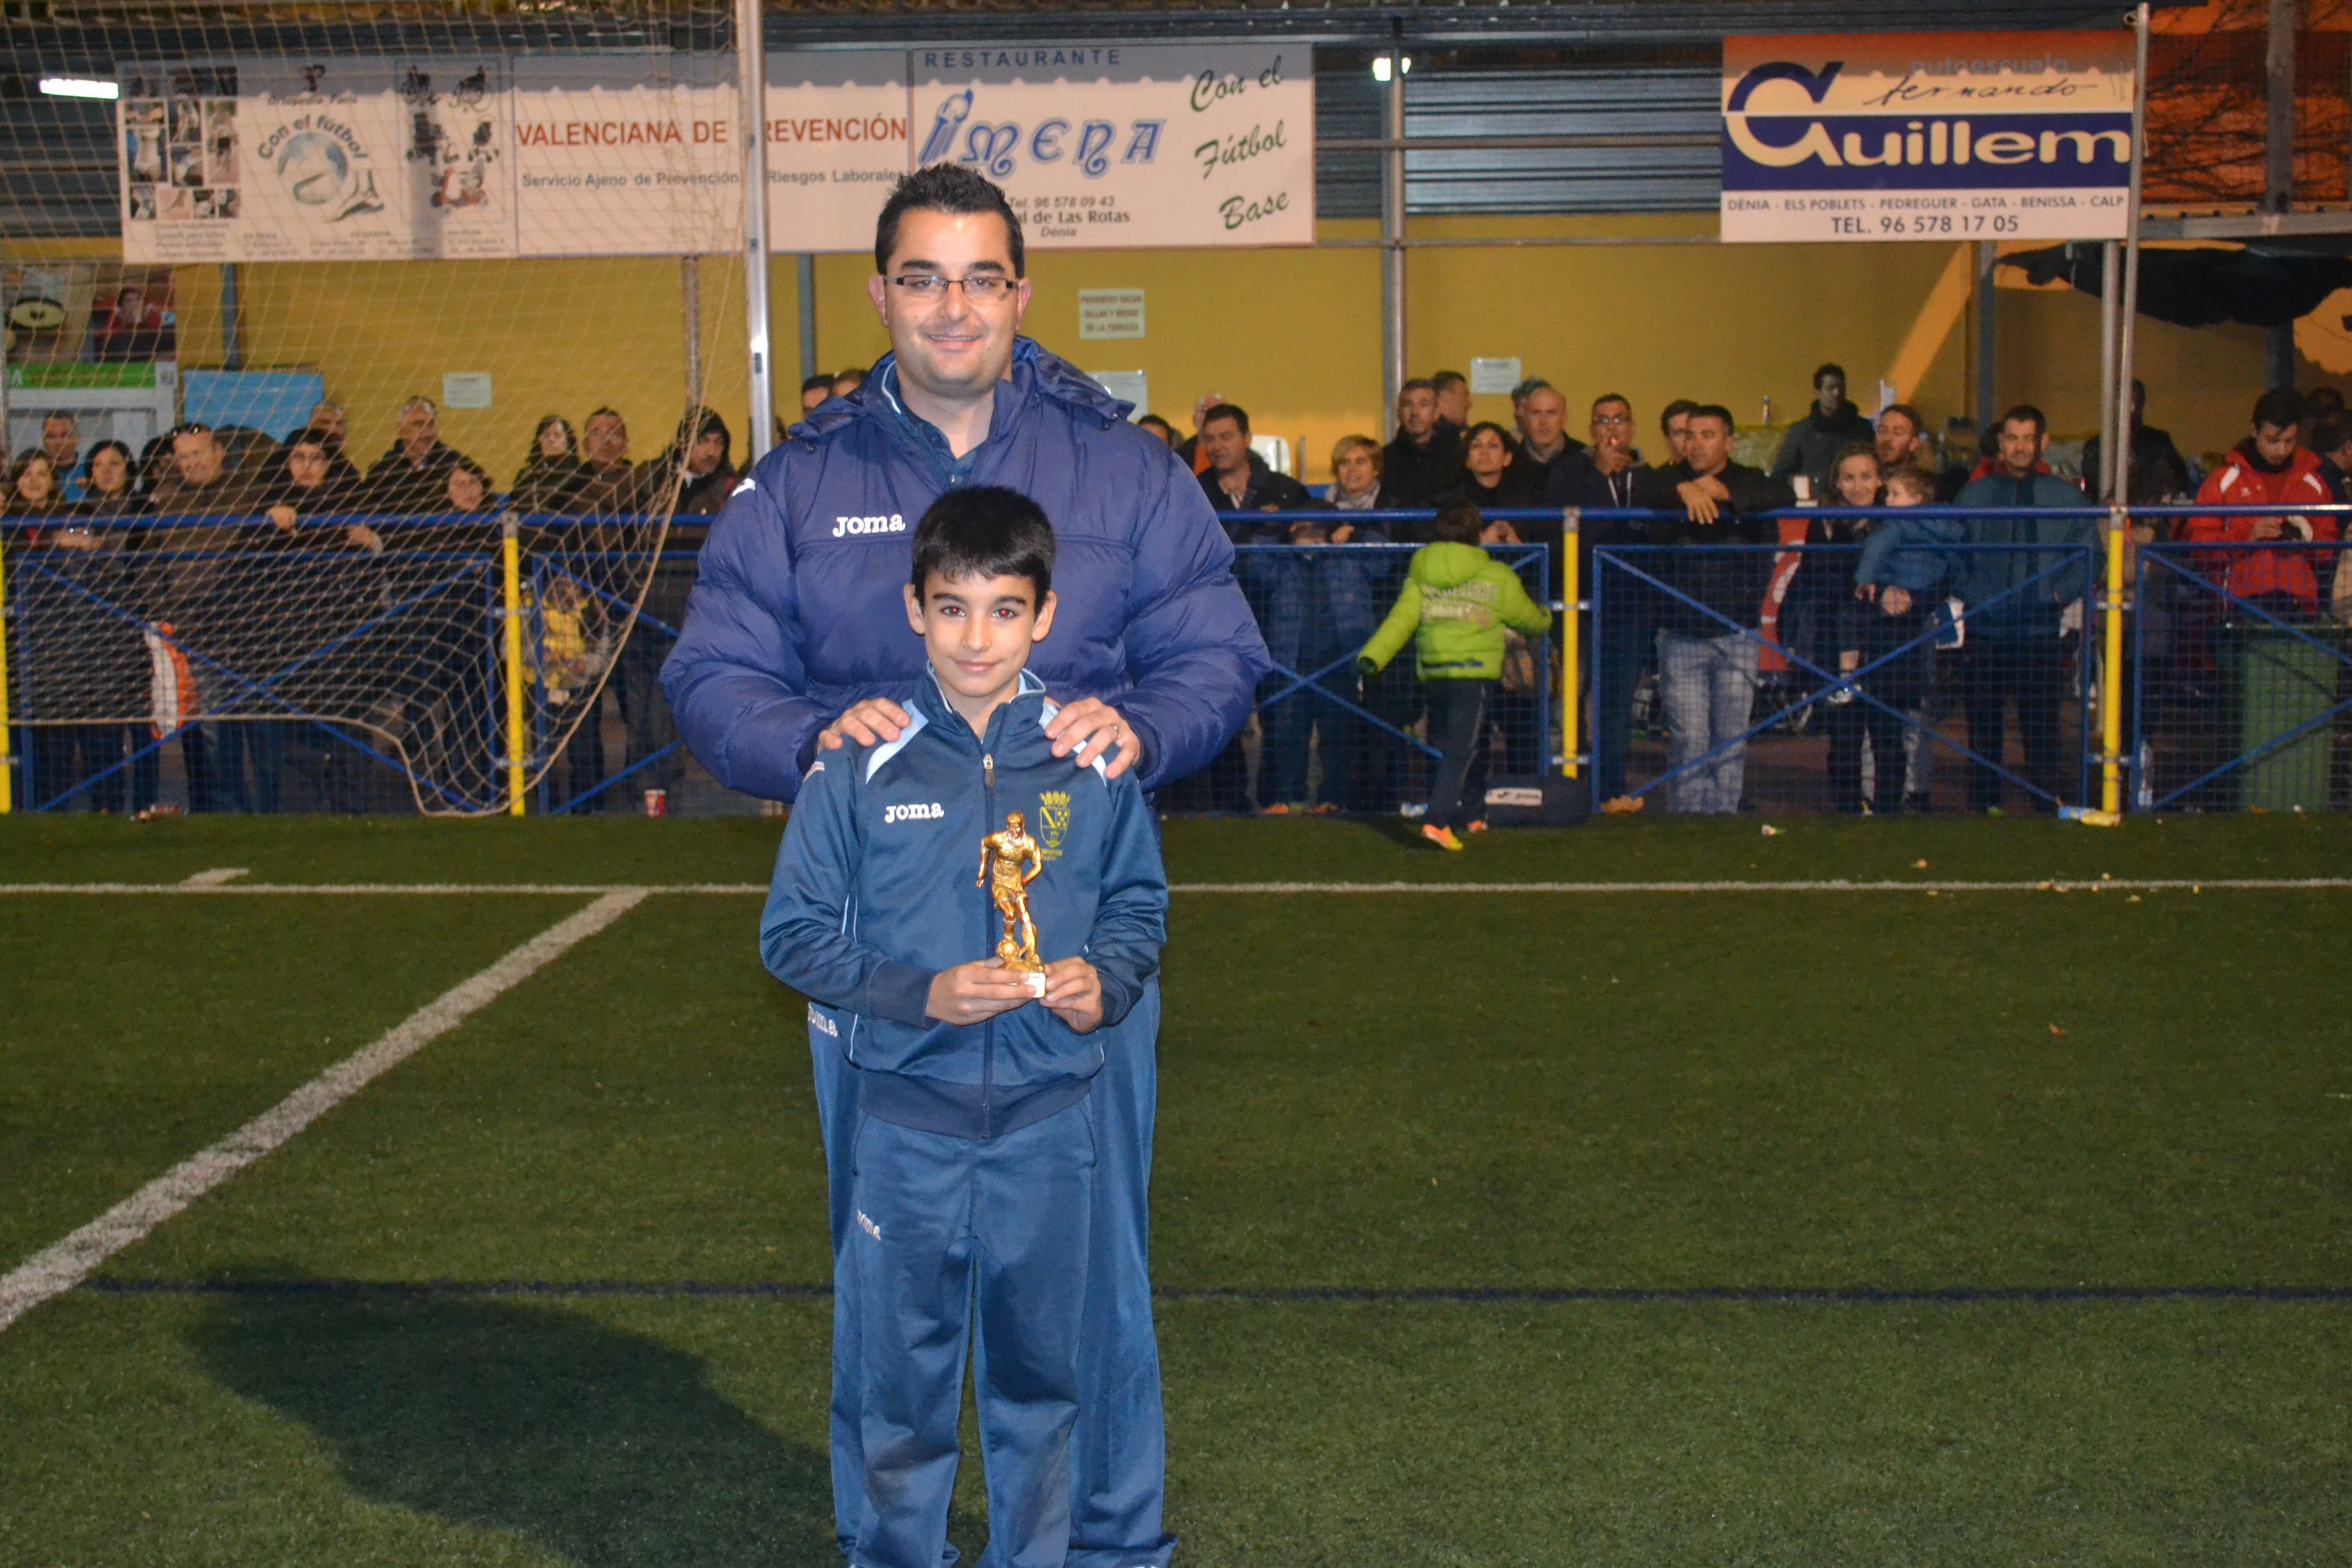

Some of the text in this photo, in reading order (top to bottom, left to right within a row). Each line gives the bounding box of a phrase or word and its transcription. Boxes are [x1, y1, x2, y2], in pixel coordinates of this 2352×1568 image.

[925, 51, 1122, 68] RESTAURANTE
[1911, 53, 2069, 75] autoescuela
[1191, 55, 1283, 112] Con el
[1726, 61, 2131, 167] Guillem
[258, 126, 289, 159] Con
[293, 114, 310, 130] el
[517, 113, 907, 146] VALENCIANA DE EVENCIÓN
[1194, 119, 1286, 179] Fútbol
[522, 174, 581, 187] Servicio
[586, 174, 627, 189] Ajeno
[634, 173, 652, 185] de
[656, 172, 739, 185] Prevención
[832, 168, 902, 183] Laborale
[1034, 197, 1049, 208] 96
[1054, 197, 1076, 208] 578
[1218, 192, 1290, 230] Base
[1784, 199, 1805, 210] ELS
[1810, 199, 1866, 211] POBLETS
[1880, 198, 1957, 209] PEDREGUER
[1971, 198, 2007, 208] GATA
[2021, 197, 2076, 208] BENISSA
[2090, 197, 2124, 207] CALP
[1033, 210, 1052, 224] de
[1058, 210, 1082, 223] Las
[1088, 210, 1130, 223] Rotas
[1831, 215, 2019, 234] TEL. 96 578 17 05
[832, 513, 906, 537] Joma
[885, 802, 944, 824] Joma
